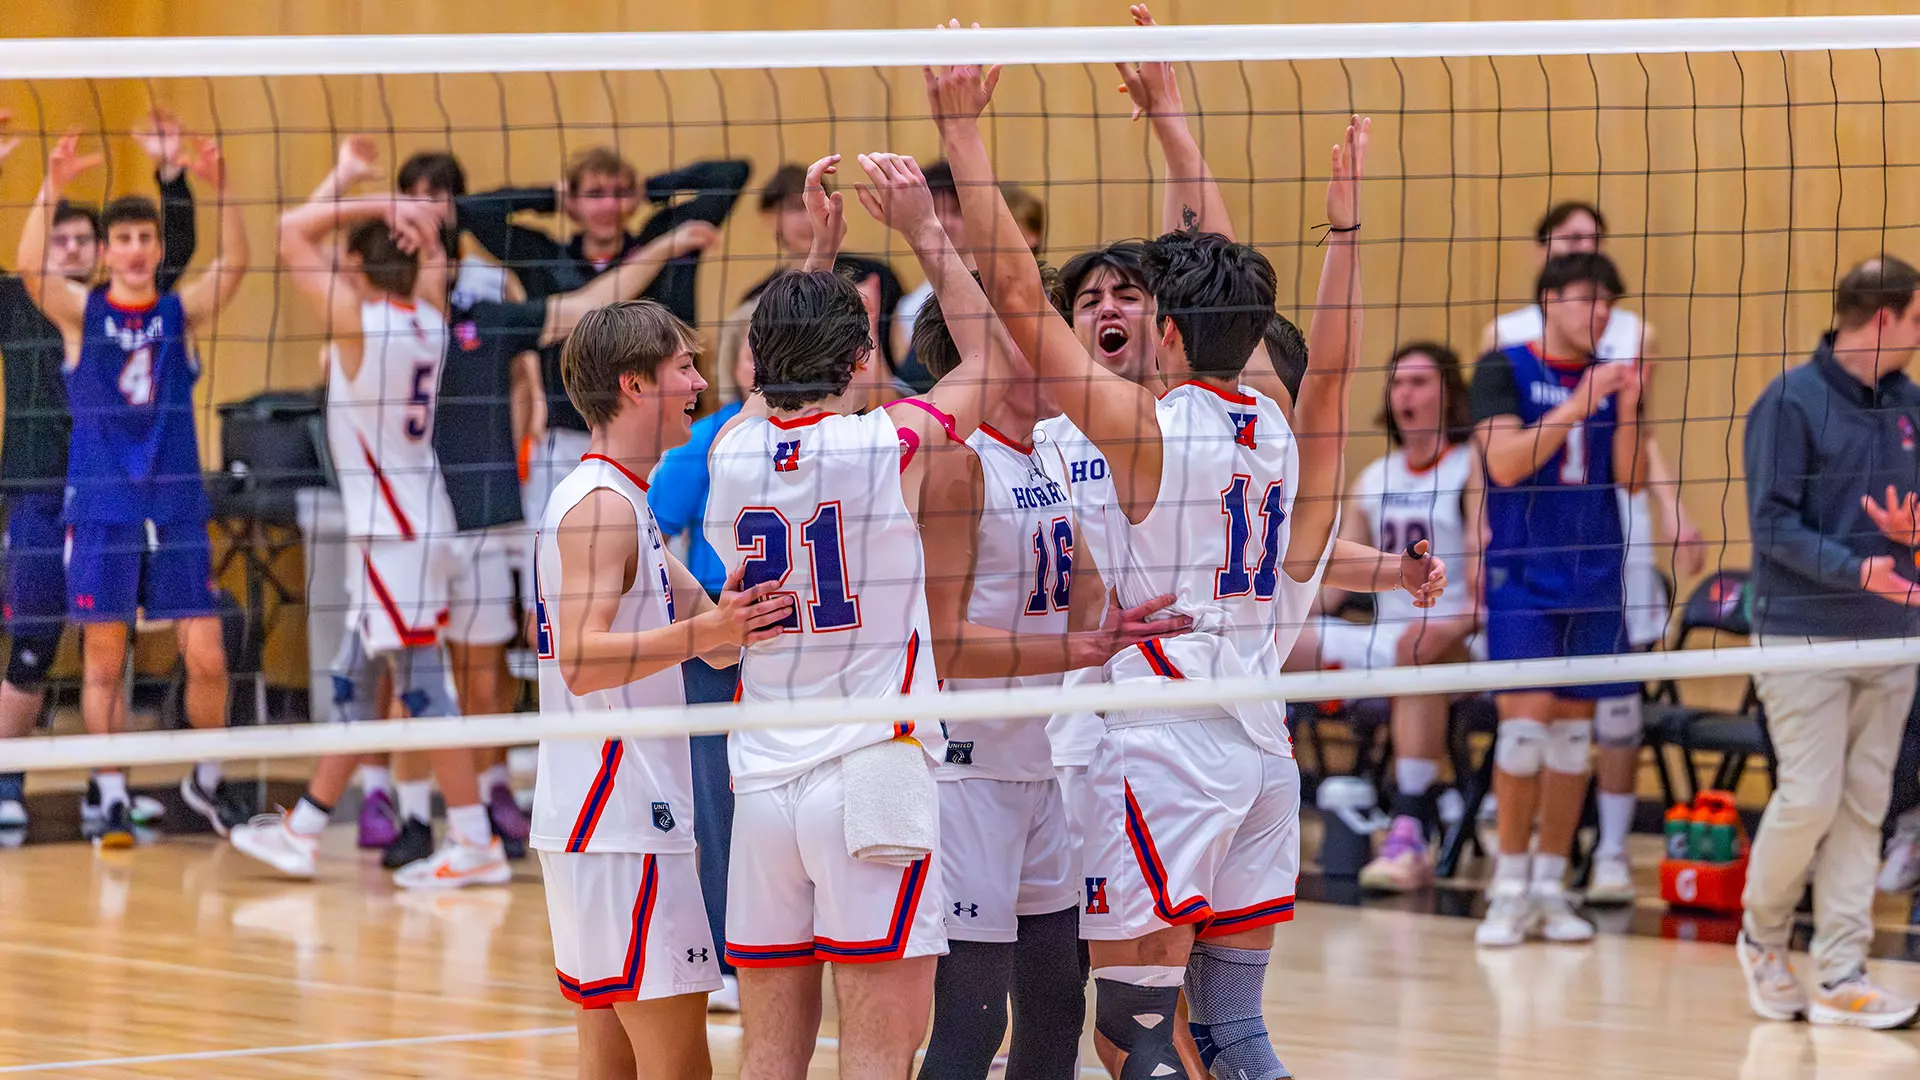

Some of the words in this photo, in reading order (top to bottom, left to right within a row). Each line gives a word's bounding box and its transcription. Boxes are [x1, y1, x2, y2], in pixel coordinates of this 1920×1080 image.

[404, 361, 434, 442] 5
[734, 500, 862, 634] 21
[1024, 516, 1073, 616] 16
[1214, 473, 1288, 601] 11
